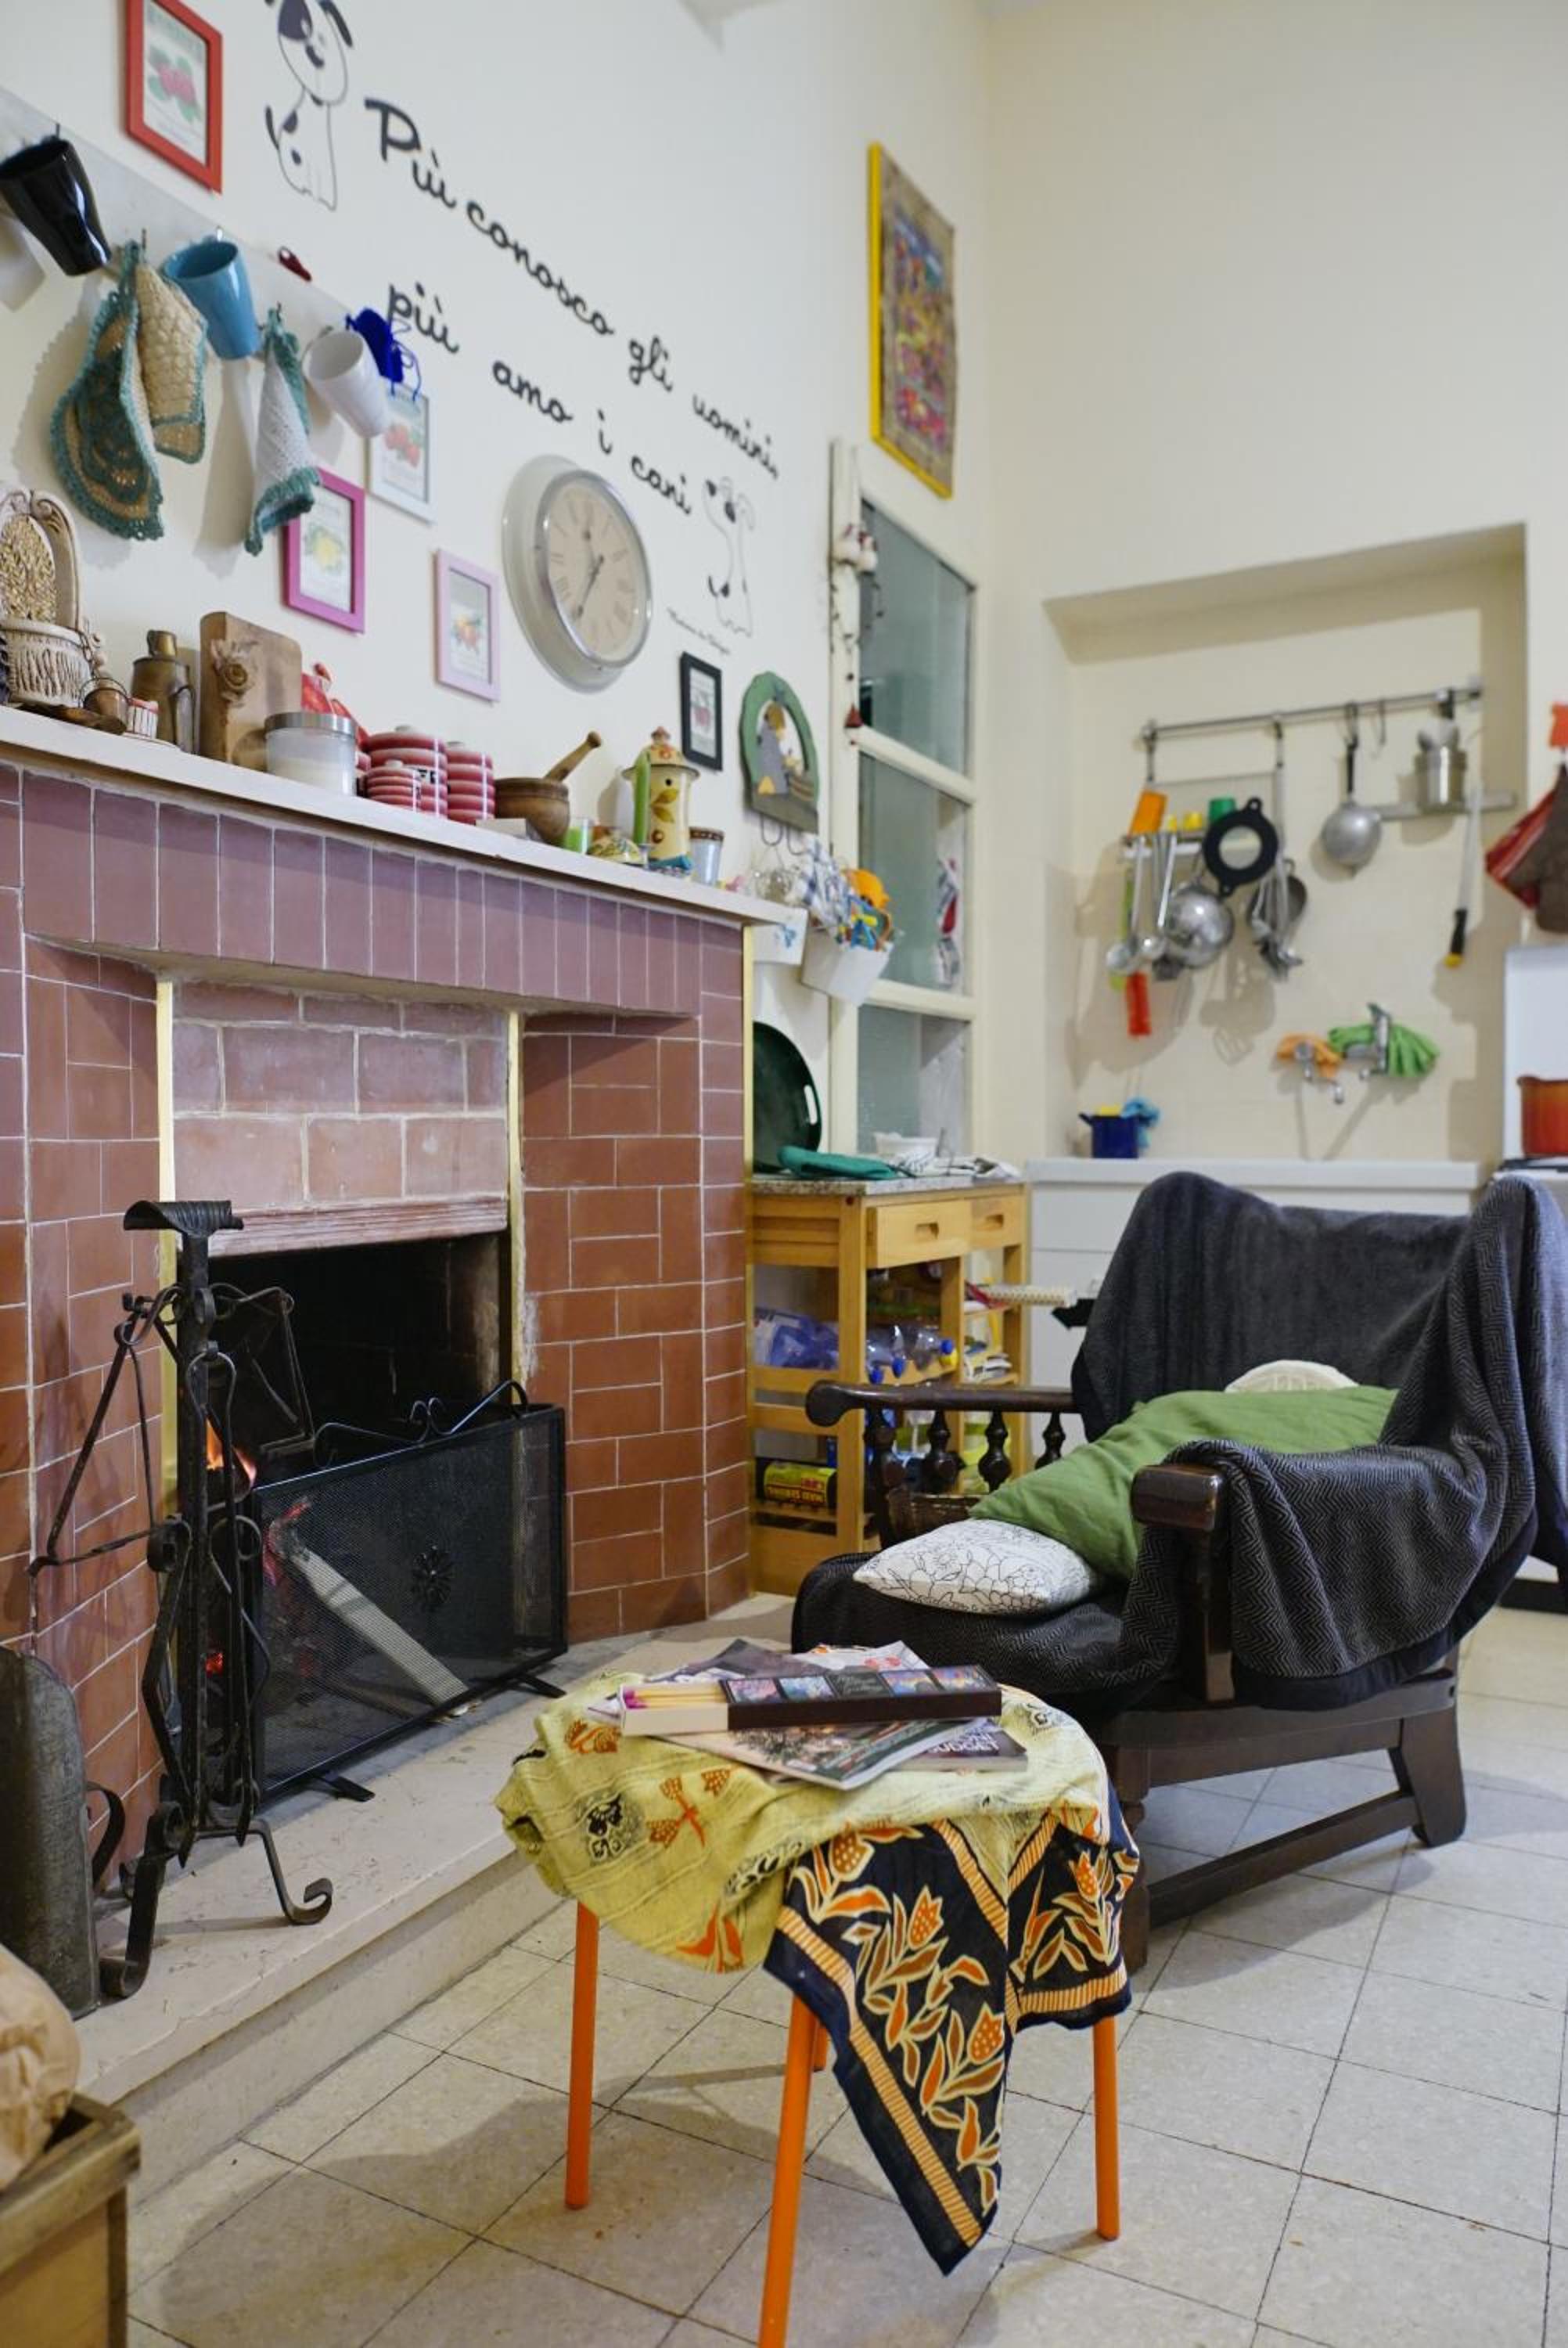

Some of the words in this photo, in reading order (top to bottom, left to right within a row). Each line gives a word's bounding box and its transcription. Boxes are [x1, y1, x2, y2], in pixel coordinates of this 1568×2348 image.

[364, 97, 457, 209] Più
[466, 200, 615, 336] conosco
[628, 336, 673, 392] gli
[388, 282, 459, 355] più
[492, 361, 574, 423] amo
[596, 409, 613, 456] i
[631, 456, 692, 515] cani
